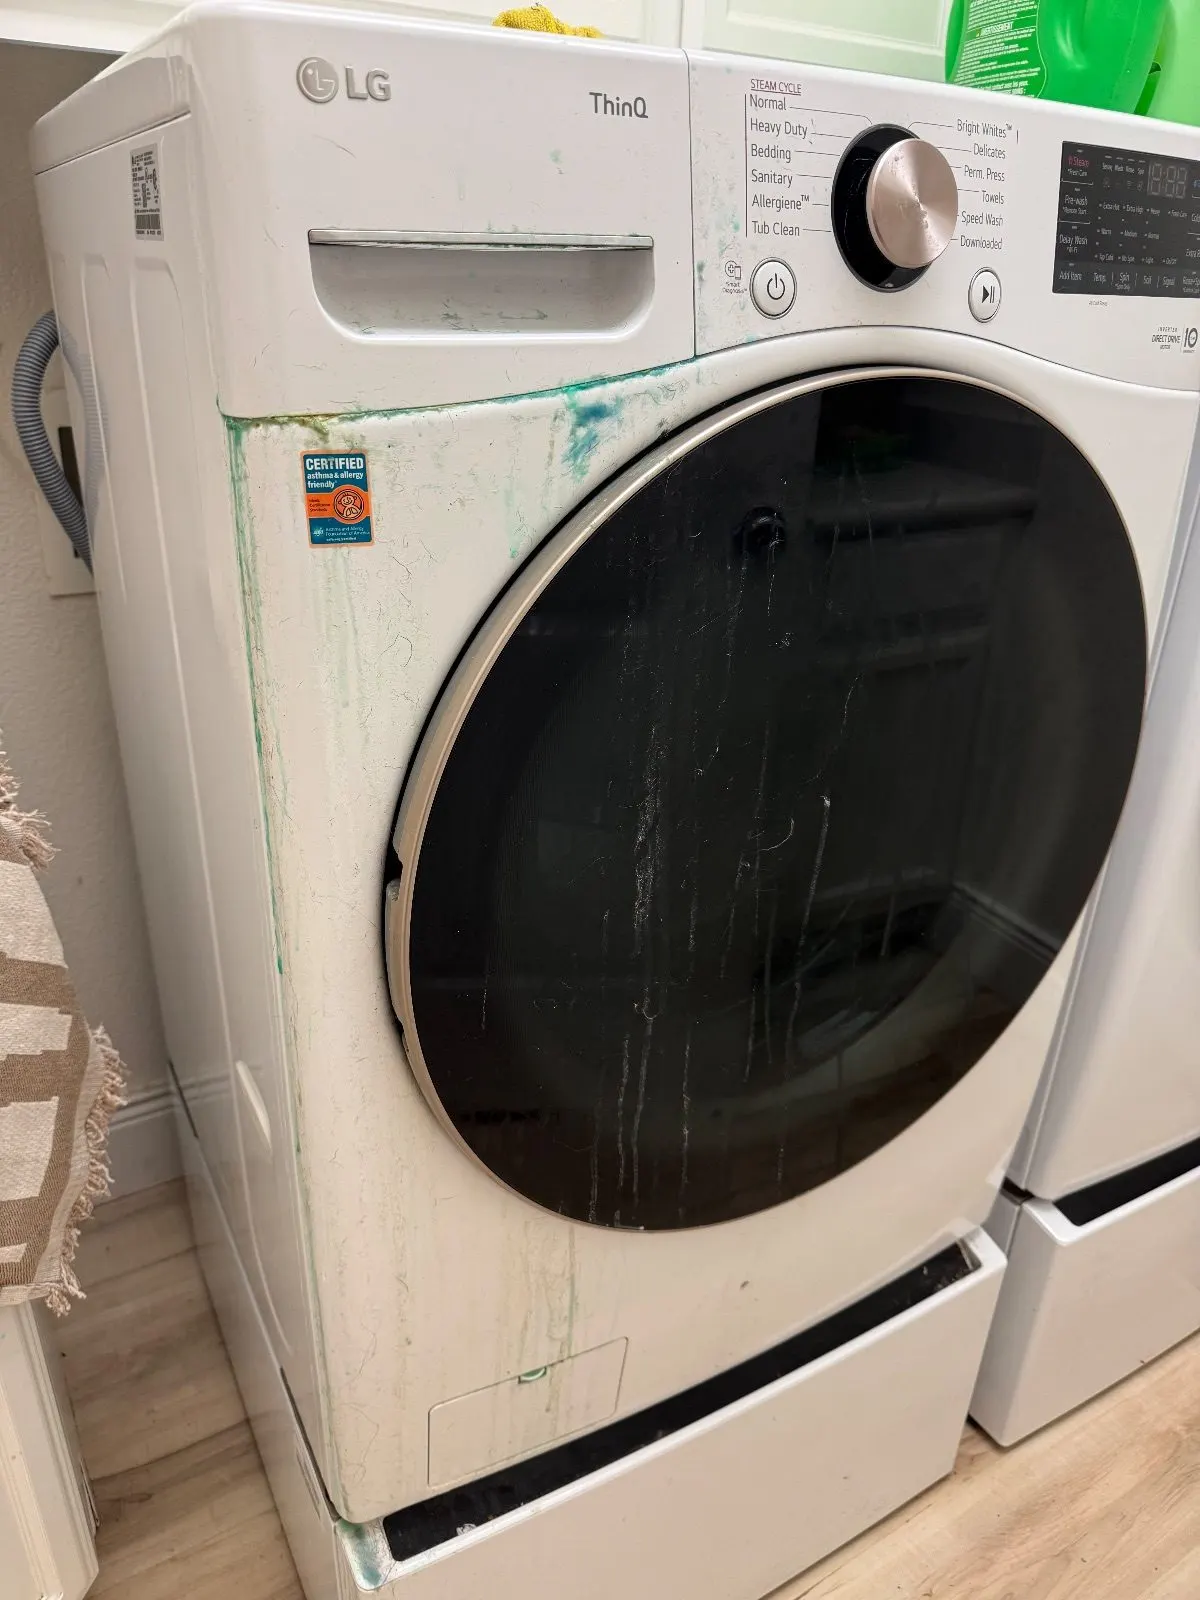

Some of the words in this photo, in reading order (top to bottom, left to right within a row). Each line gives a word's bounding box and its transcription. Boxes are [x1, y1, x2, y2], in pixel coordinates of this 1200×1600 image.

[345, 65, 391, 101] LG
[751, 78, 777, 91] STEAM
[778, 81, 802, 94] CYCLE
[589, 92, 649, 119] ThinQ
[749, 93, 787, 111] Normal
[750, 117, 782, 137] Heavy
[784, 121, 808, 140] Duty
[957, 118, 980, 136] Bright
[751, 143, 792, 164] Bedding
[973, 143, 1006, 159] Delicates
[751, 168, 793, 188] Sanitary
[964, 164, 985, 180] Perm.
[986, 168, 1005, 182] Press
[982, 190, 1005, 205] Towels
[961, 210, 984, 226] Speed
[985, 214, 1004, 227] Wash
[752, 220, 770, 235] Tub
[772, 221, 800, 237] Clean
[960, 234, 1003, 250] Downloaded
[1059, 234, 1073, 245] Delay
[1074, 236, 1088, 245] Wash
[1059, 270, 1071, 280] Add
[1119, 272, 1130, 284] Spin
[1152, 334, 1168, 343] DIRECT
[1167, 335, 1181, 344] DRIVE
[1183, 327, 1199, 349] 10
[305, 457, 364, 470] CERTIFIED
[306, 471, 334, 480] asthma
[334, 471, 340, 479] &
[340, 470, 364, 480] allergy
